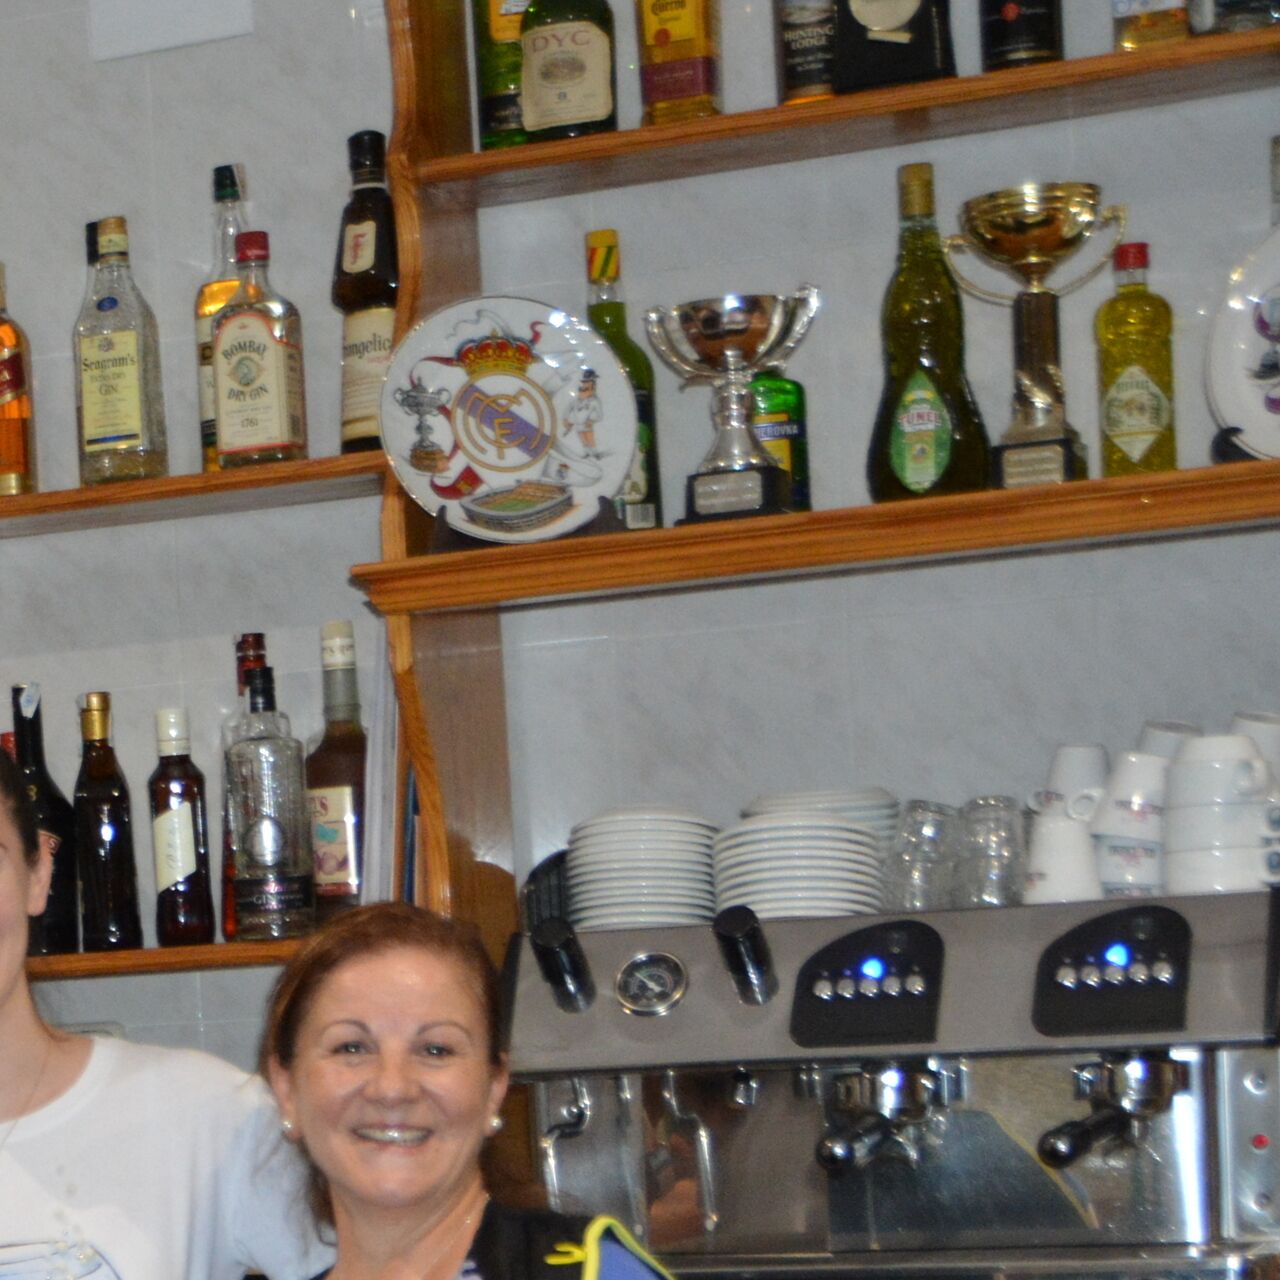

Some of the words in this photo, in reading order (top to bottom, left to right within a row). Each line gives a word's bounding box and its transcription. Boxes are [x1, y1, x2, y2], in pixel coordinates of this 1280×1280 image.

[531, 29, 592, 52] DYC
[784, 24, 834, 40] HUNTING
[791, 36, 828, 50] LODGE
[222, 340, 267, 361] BOMBAY
[82, 353, 137, 372] Seagram's
[227, 388, 247, 402] DRY
[249, 384, 269, 398] GIN
